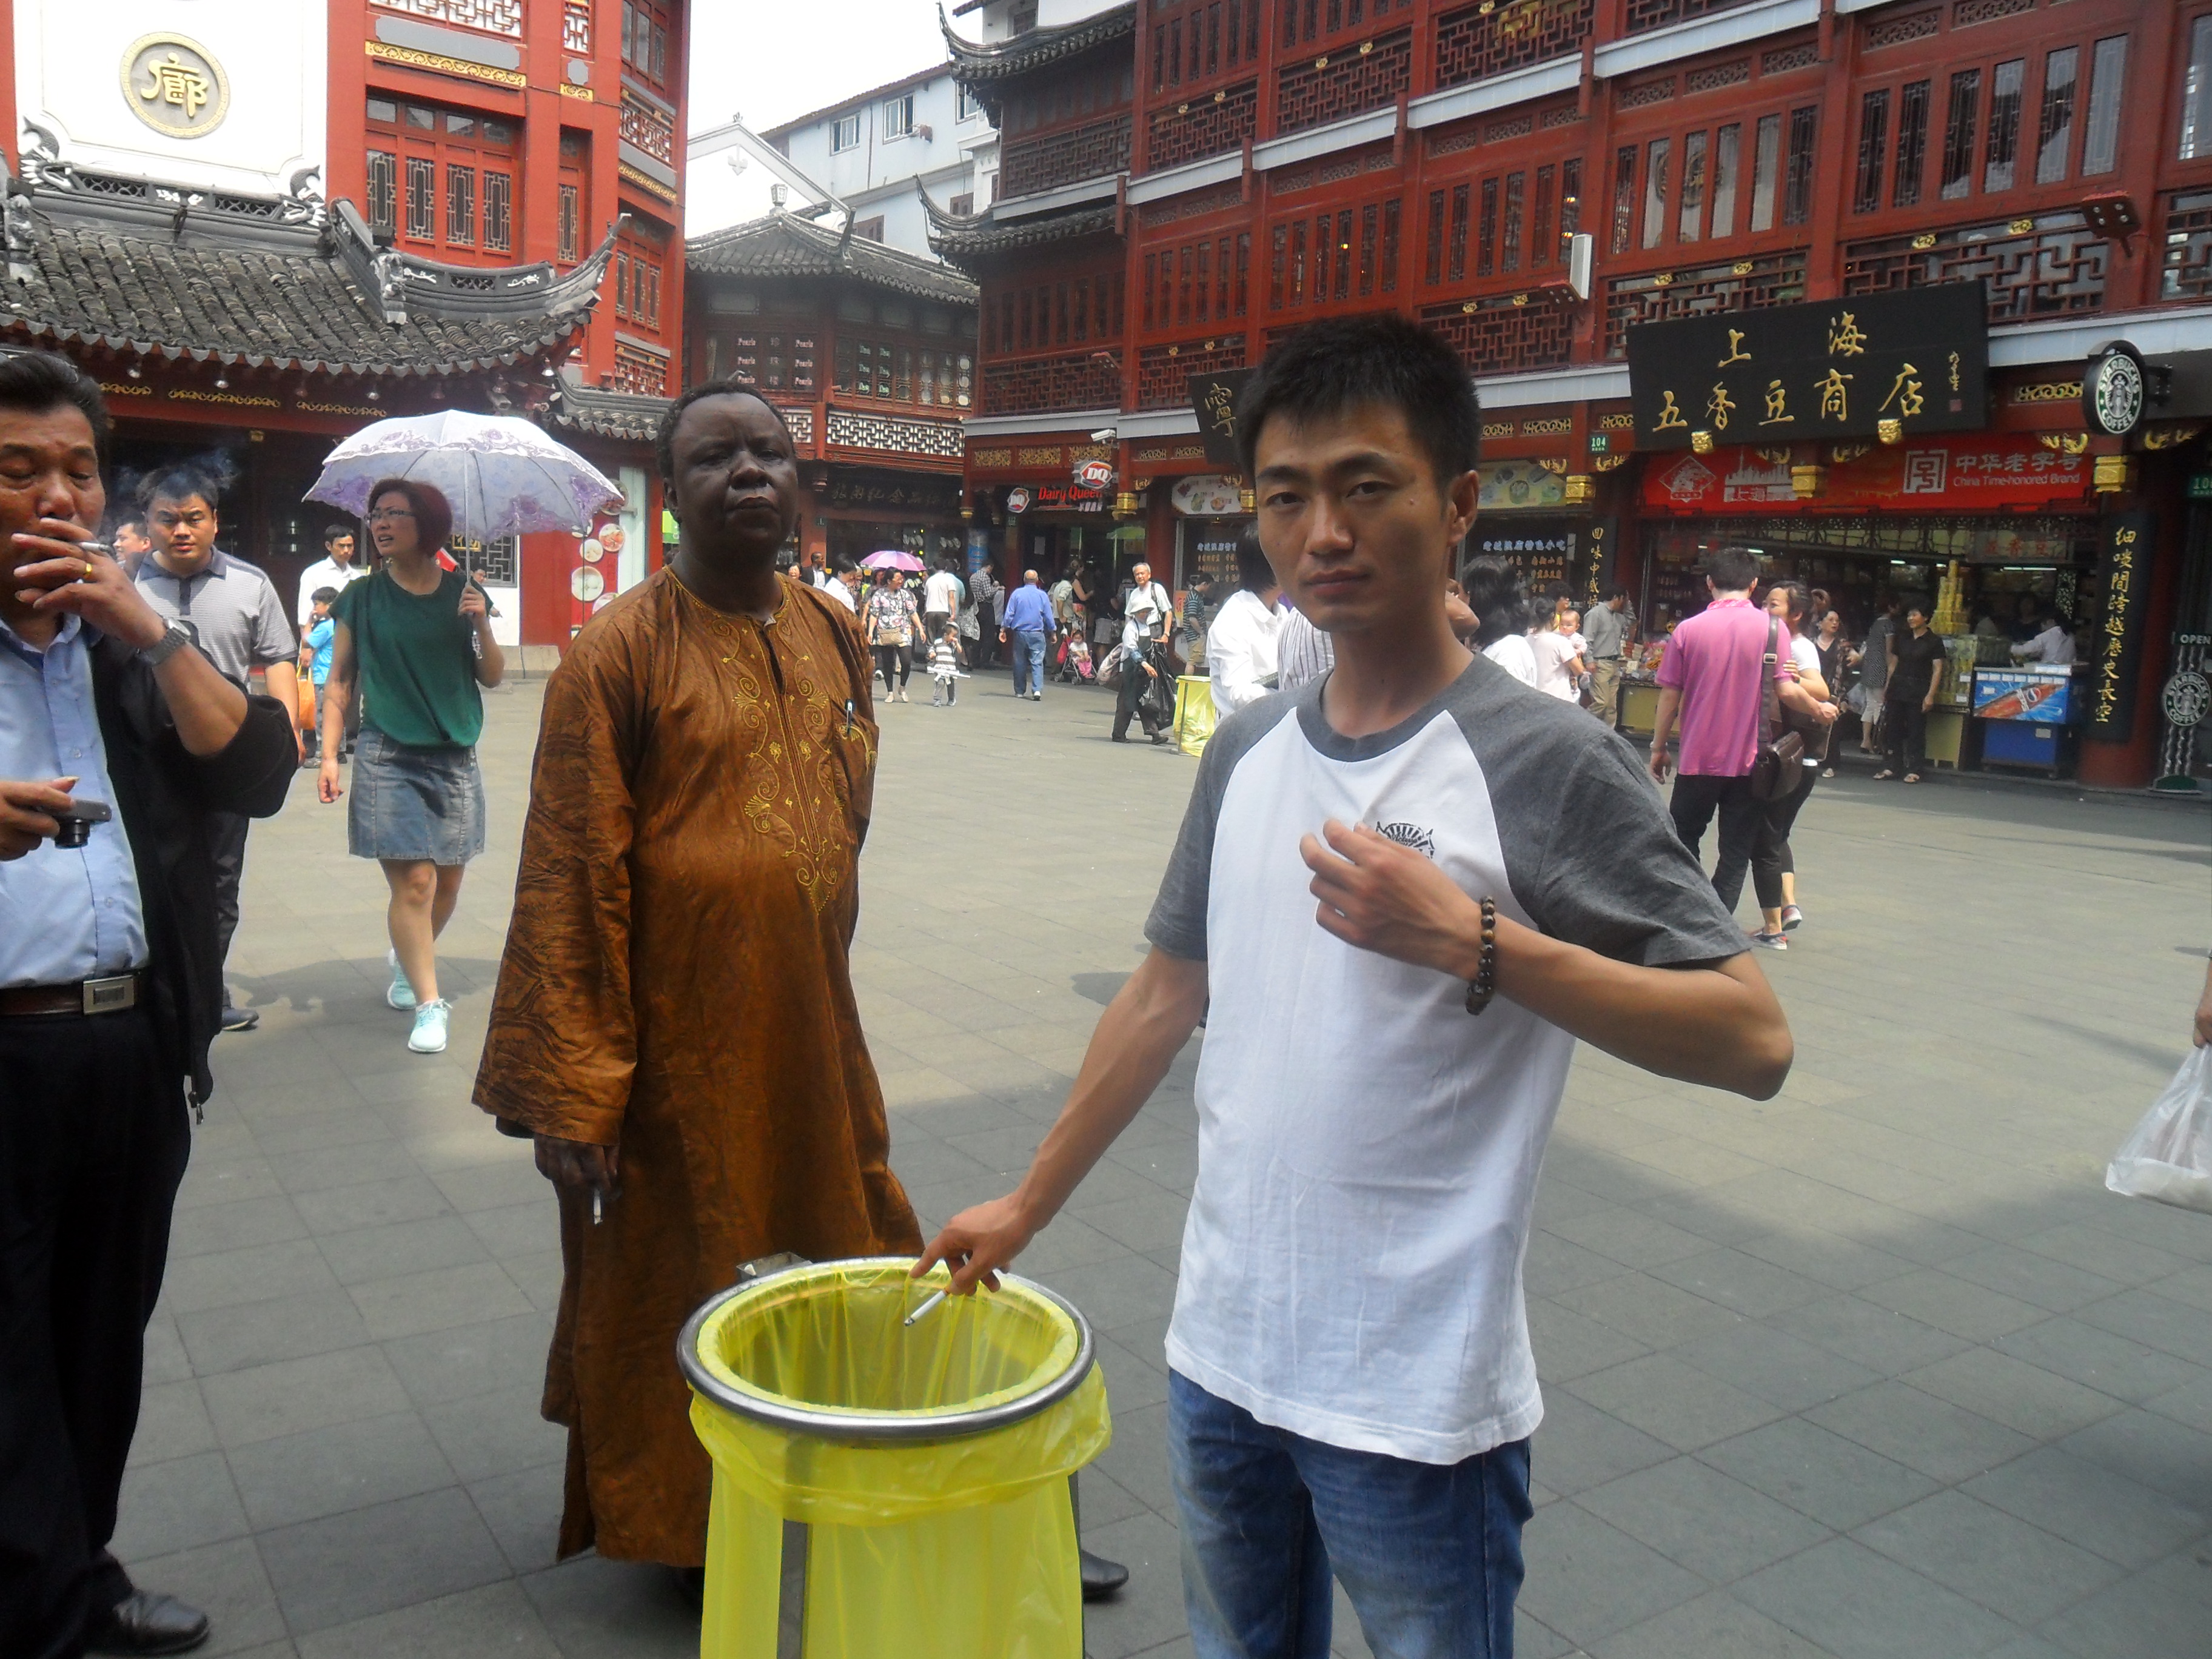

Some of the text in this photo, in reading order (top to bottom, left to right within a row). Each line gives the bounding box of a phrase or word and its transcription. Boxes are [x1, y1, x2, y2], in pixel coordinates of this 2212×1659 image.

[1718, 311, 1867, 367] 上海
[2100, 358, 2140, 393] STARBUCKS
[1652, 364, 1923, 432] 五香豆商店
[2101, 409, 2134, 430] COFFEE
[1591, 437, 1606, 447] 104
[1087, 468, 1108, 483] DQ
[1953, 473, 2080, 486] China Time-honored Brand
[1009, 494, 1025, 506] DQ
[1038, 486, 1102, 501] Dairy Queen
[2180, 634, 2211, 645] OPEN
